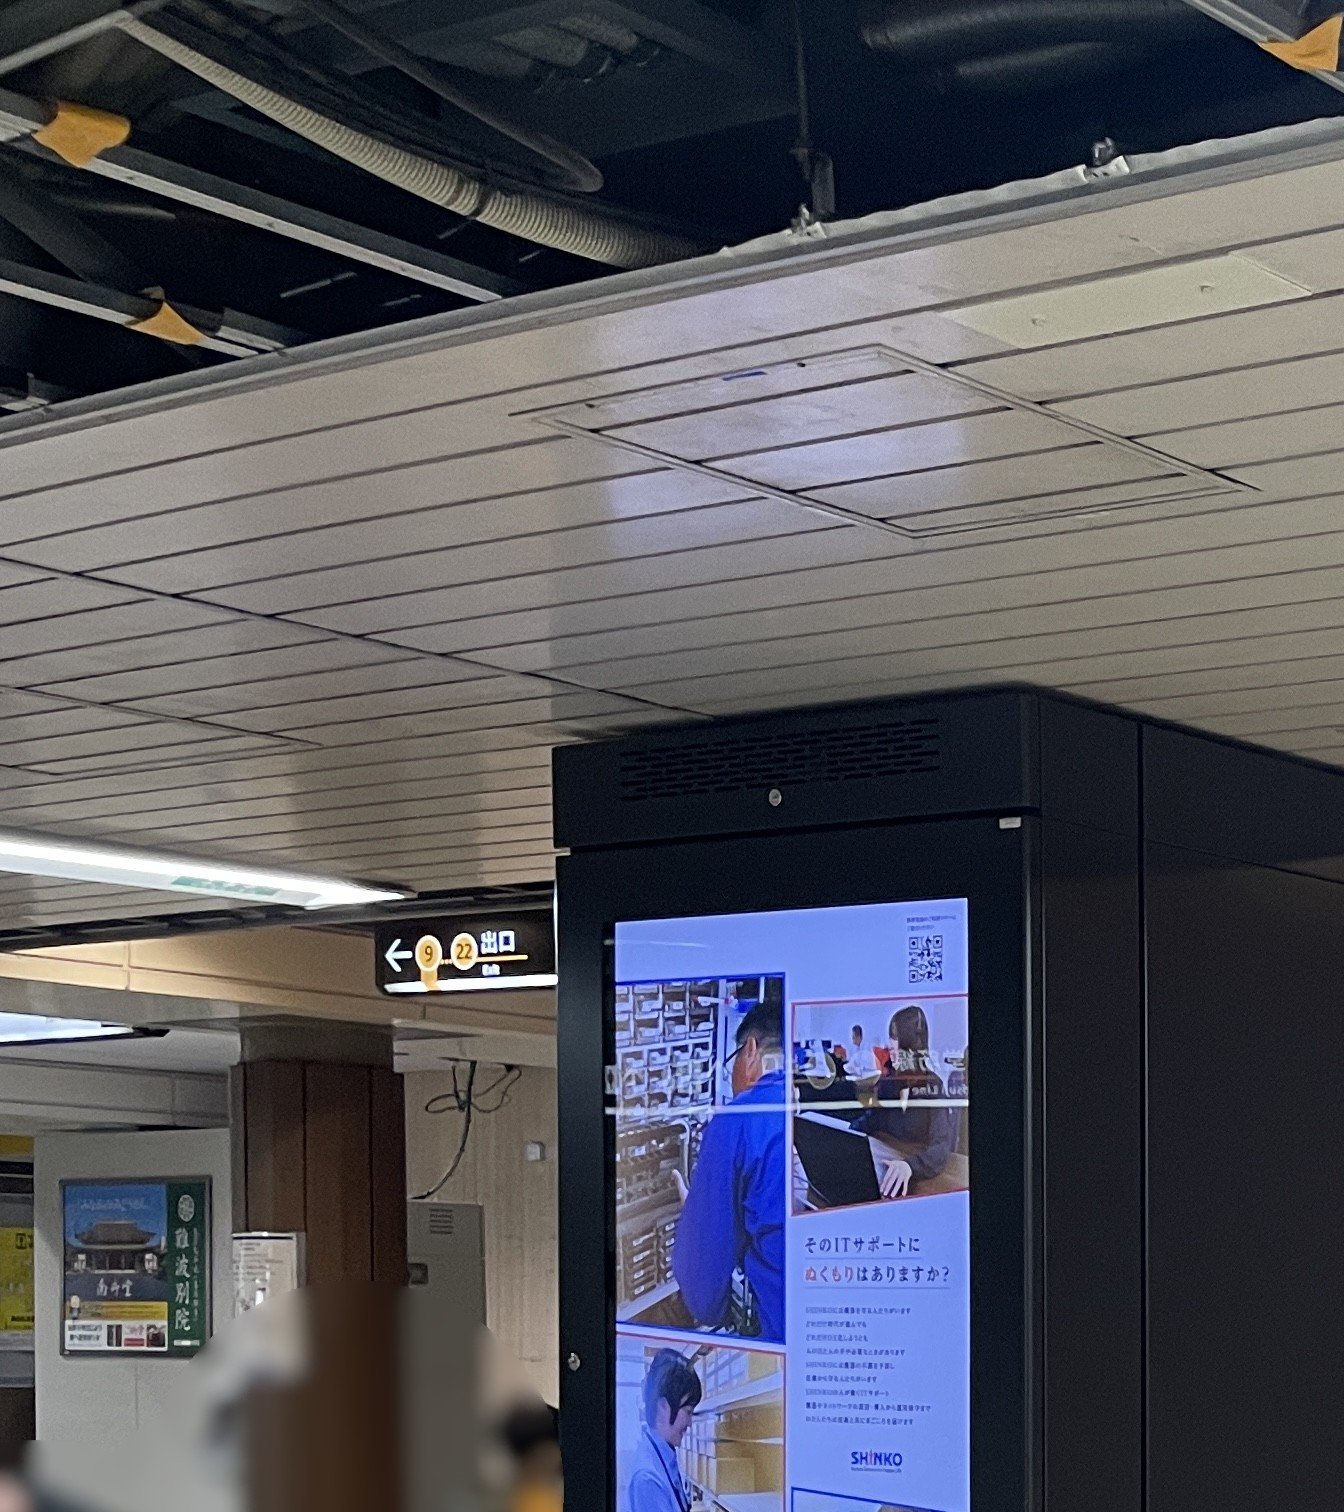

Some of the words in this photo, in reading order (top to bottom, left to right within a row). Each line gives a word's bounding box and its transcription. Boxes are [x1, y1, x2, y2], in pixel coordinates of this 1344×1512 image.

[456, 943, 472, 959] 22
[481, 931, 515, 954] 出口
[805, 1236, 920, 1253] そのITサポートに
[851, 1449, 902, 1466] SHINKO
